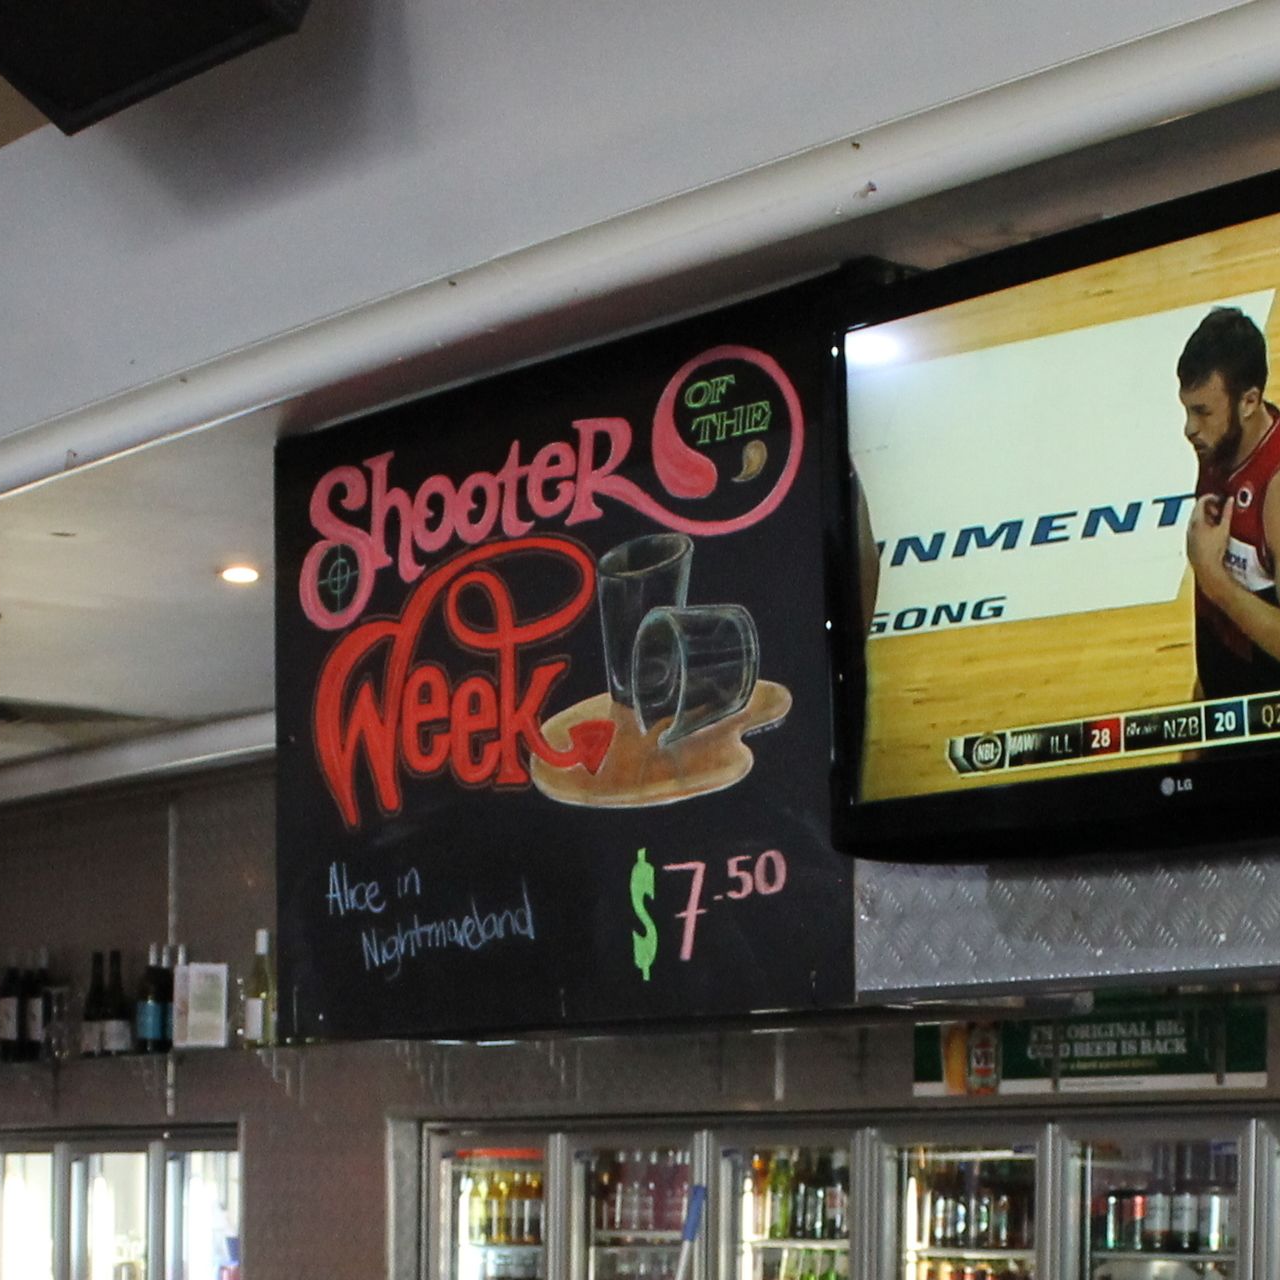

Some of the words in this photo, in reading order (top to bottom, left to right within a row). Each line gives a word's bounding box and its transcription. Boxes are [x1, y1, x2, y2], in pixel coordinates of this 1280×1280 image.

[684, 374, 735, 409] OF
[691, 400, 772, 446] THE
[313, 537, 600, 830] Week
[1091, 727, 1111, 749] 28
[1163, 713, 1199, 739] NZB
[1214, 712, 1236, 732] 20
[1176, 778, 1193, 791] LG
[326, 862, 386, 915] Alice
[397, 867, 420, 897] in
[1067, 1021, 1151, 1040] ORIGINAL
[1073, 1040, 1117, 1058] BEER
[1121, 1039, 1137, 1056] IS
[1140, 1037, 1187, 1055] BACK
